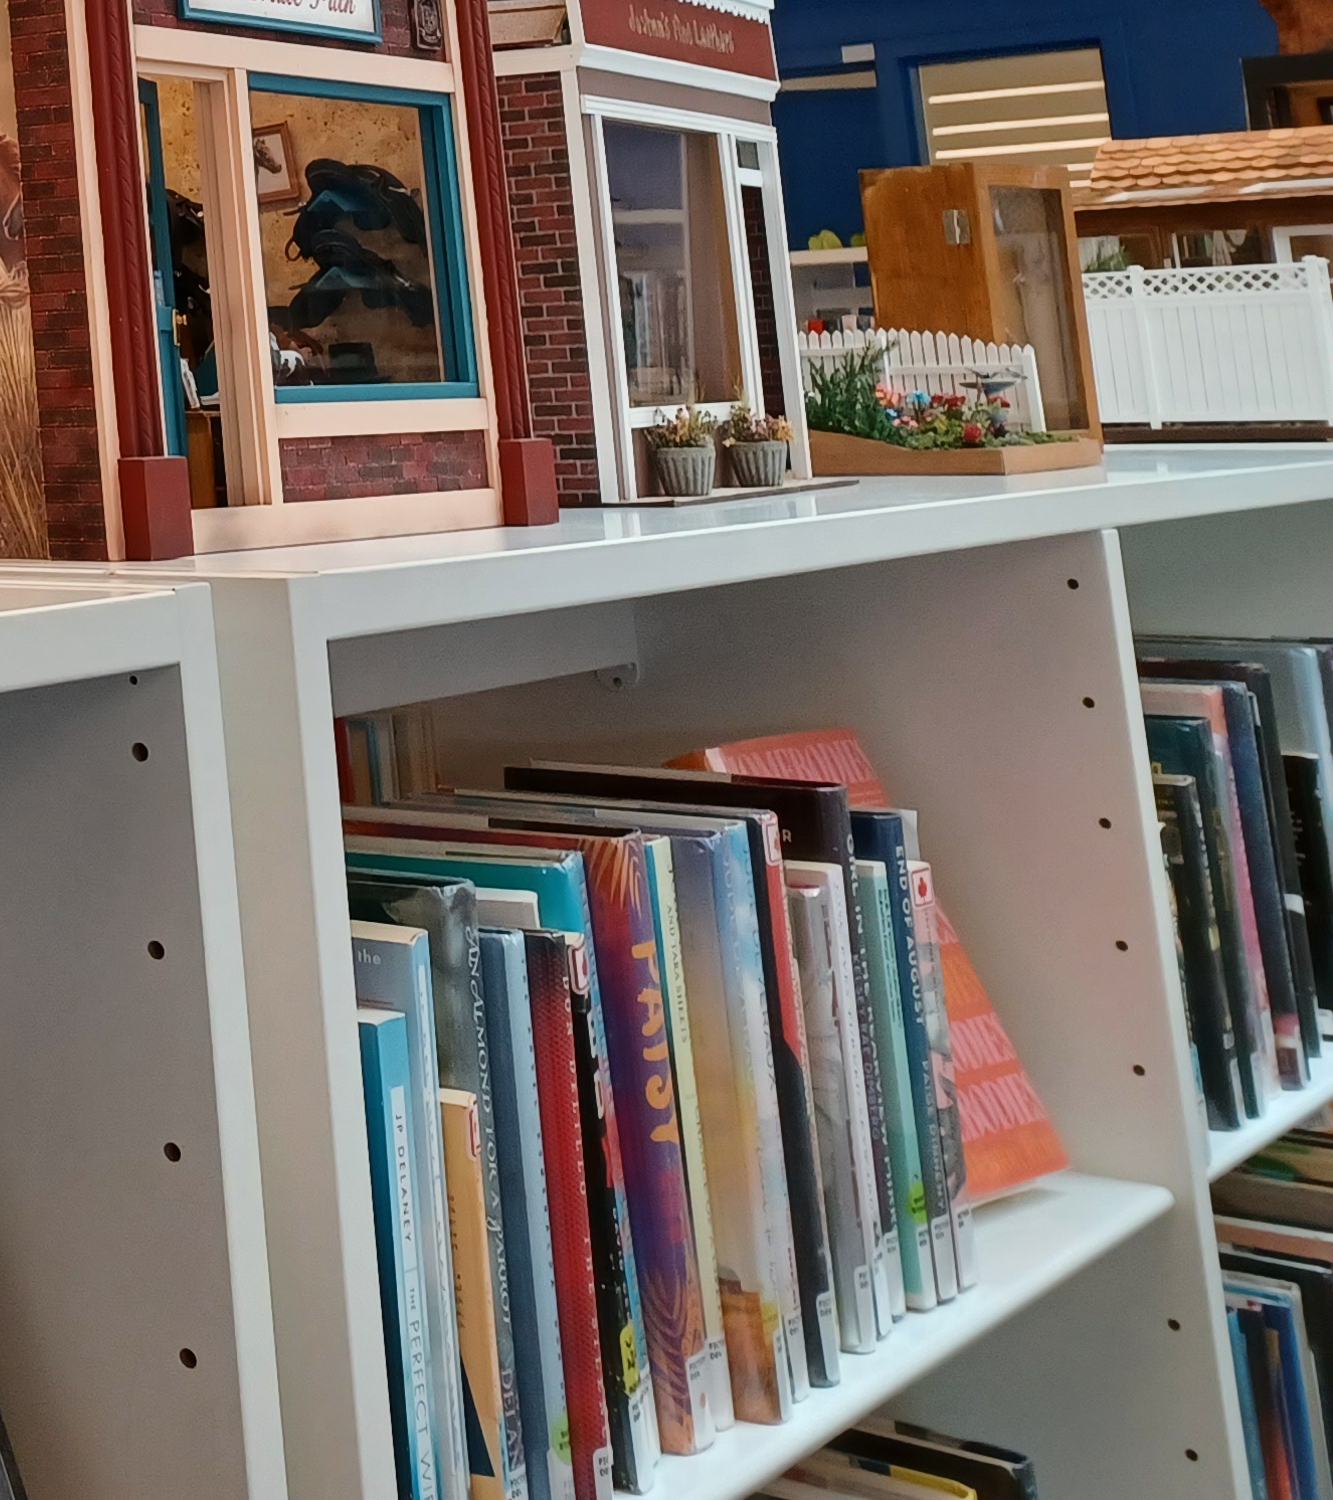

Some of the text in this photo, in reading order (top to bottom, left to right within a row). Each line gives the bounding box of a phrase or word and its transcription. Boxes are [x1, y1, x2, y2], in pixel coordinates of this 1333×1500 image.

[665, 903, 676, 939] AND
[895, 845, 927, 1025] END OF AUGUST
[356, 947, 383, 966] the
[669, 941, 681, 982] TARA
[562, 975, 575, 1037] DON
[394, 1114, 413, 1243] JP DELANEY
[409, 1319, 430, 1436] PERFECT
